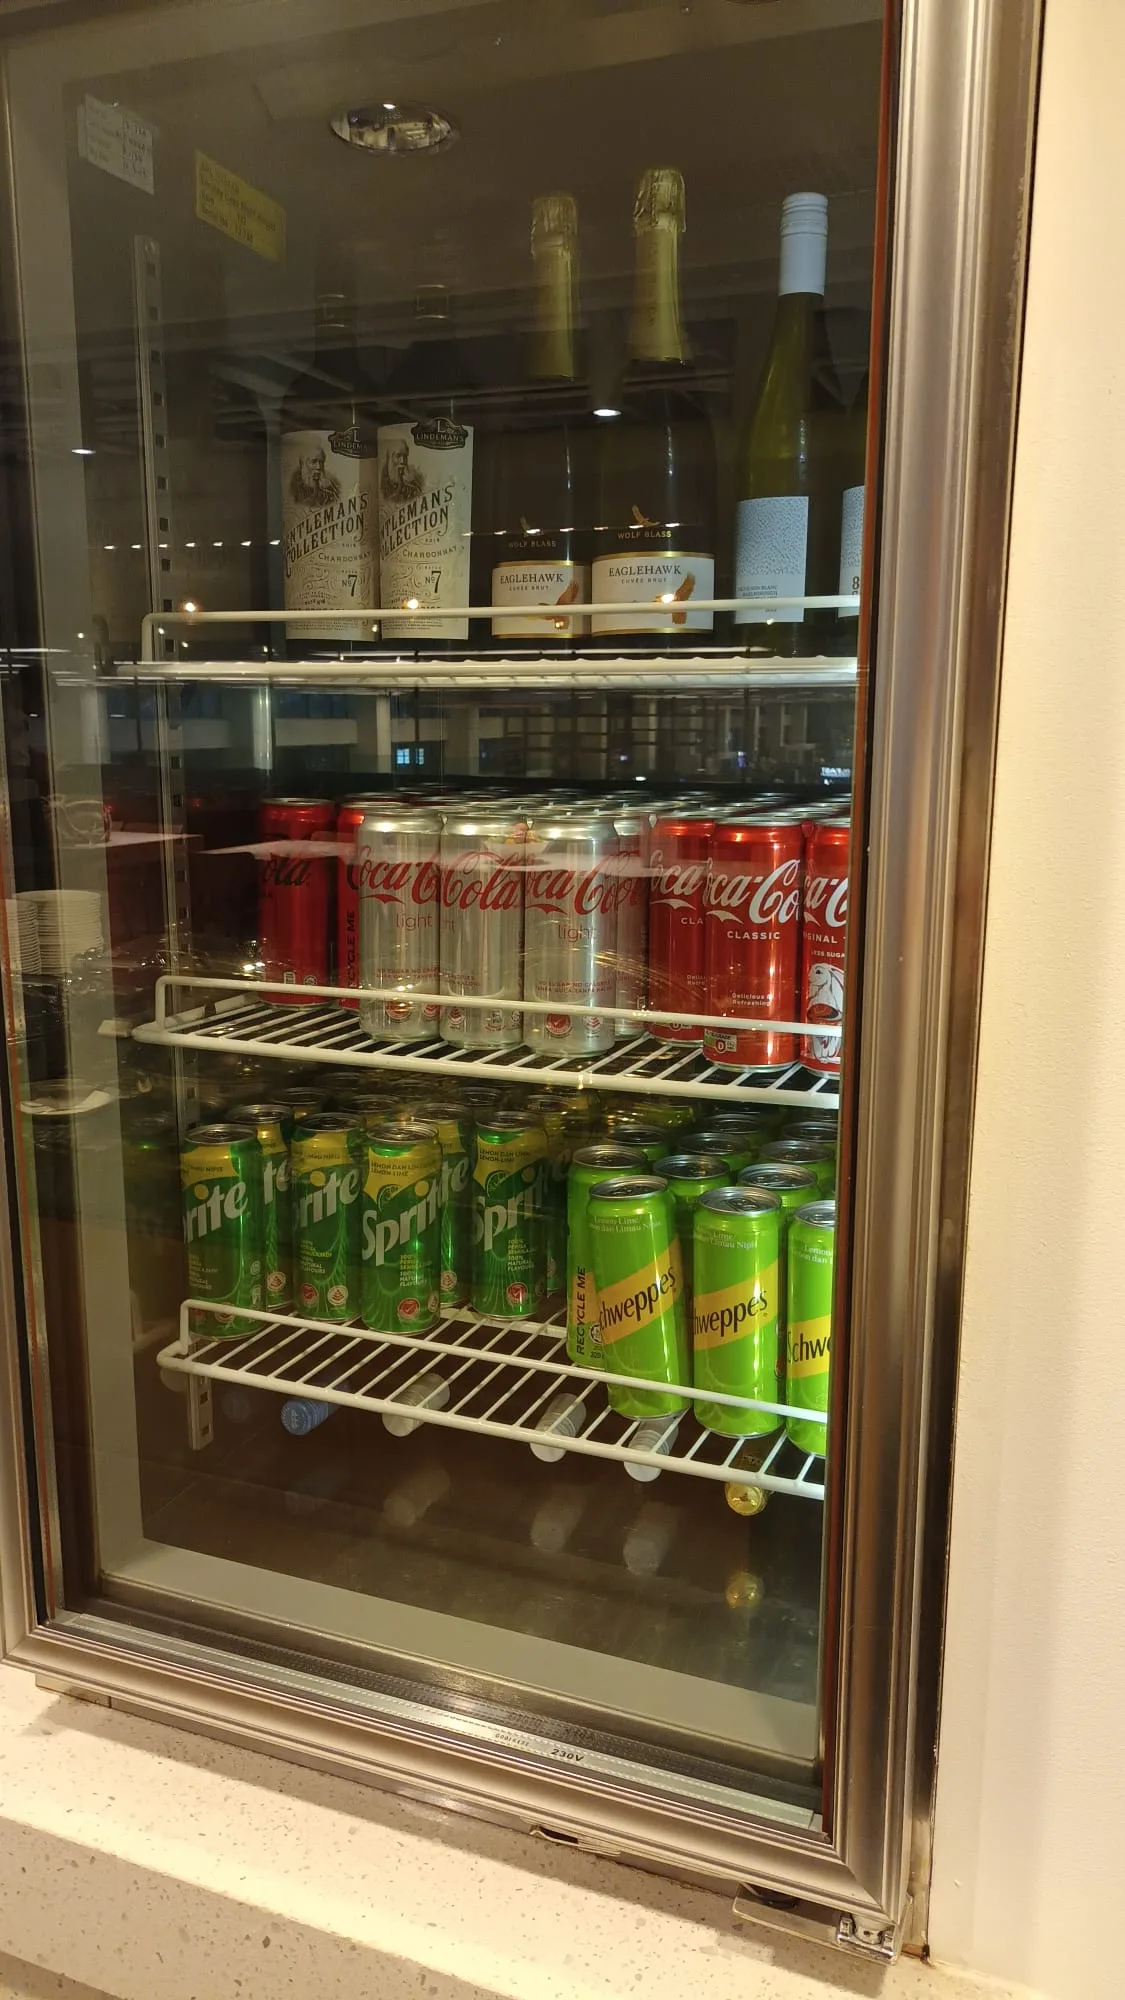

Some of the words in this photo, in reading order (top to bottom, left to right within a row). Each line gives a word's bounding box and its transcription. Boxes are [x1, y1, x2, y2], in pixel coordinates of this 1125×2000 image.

[617, 531, 641, 540] WOLF
[645, 530, 672, 539] BLASS
[500, 573, 564, 585] EAGLEHAWK
[608, 564, 682, 578] EAGLEHAWK
[396, 912, 433, 931] light
[727, 930, 781, 941] CLASSIC
[826, 951, 846, 959] SUGA
[292, 1168, 360, 1231] rite
[183, 1181, 249, 1244] rite
[576, 1266, 586, 1289] ME
[599, 1266, 677, 1331] chweppes
[576, 1291, 586, 1355] RECYCLE
[693, 1290, 768, 1338] hweppes
[550, 1748, 585, 1762] 230V
